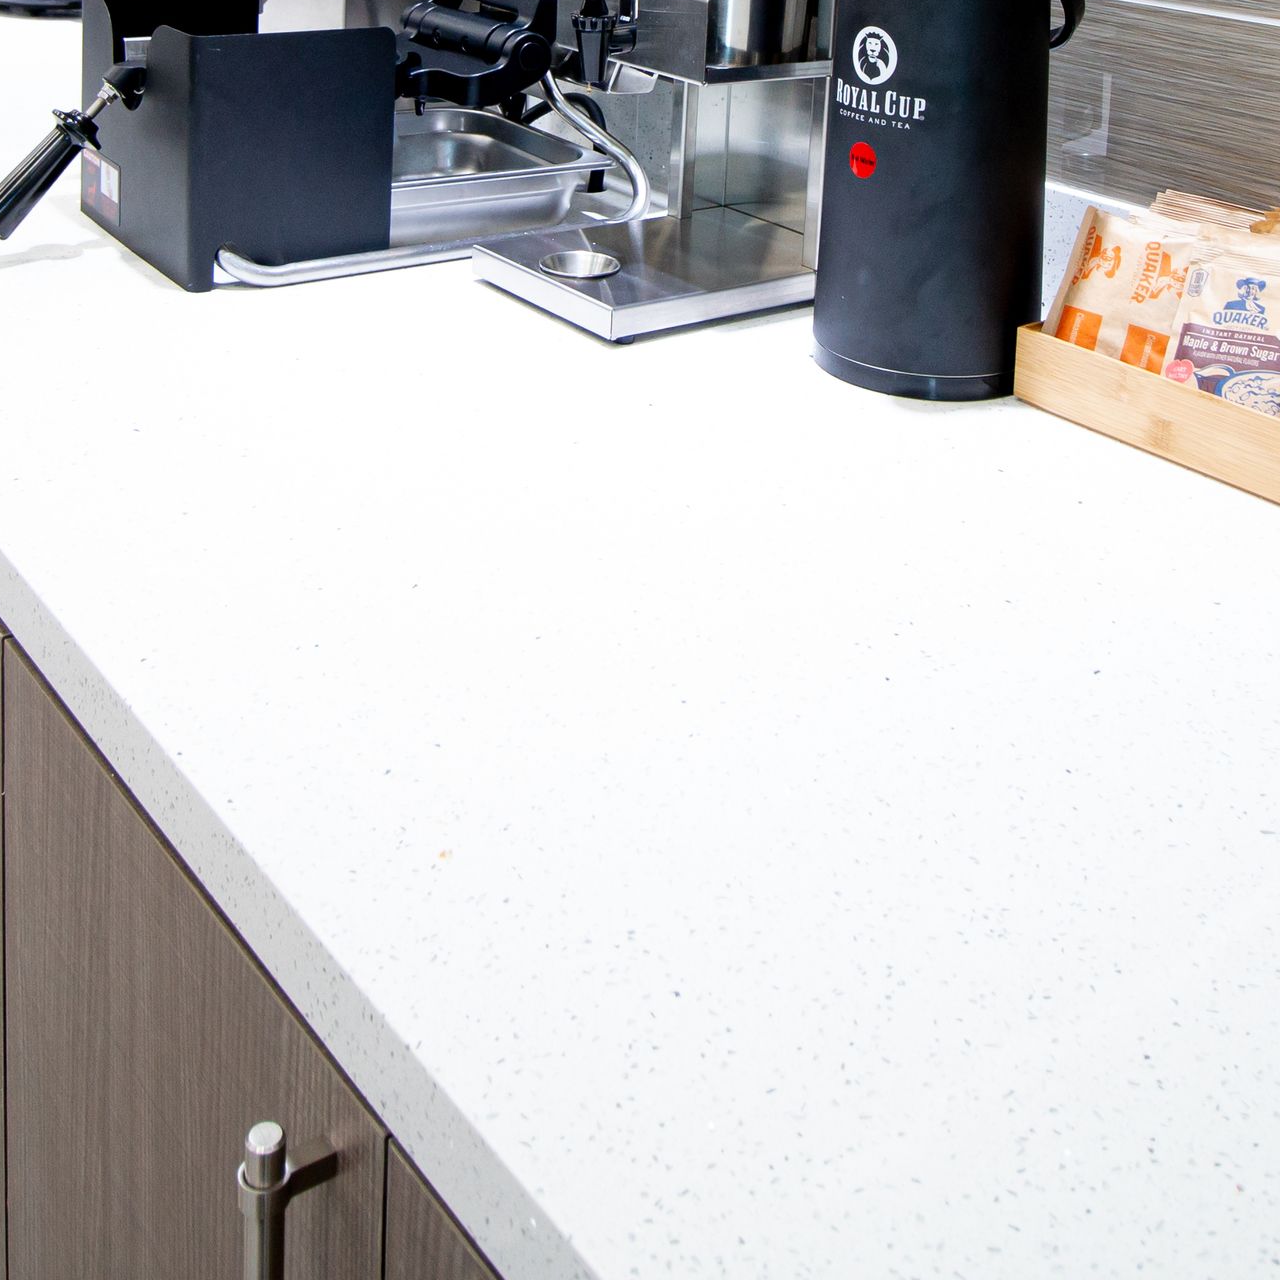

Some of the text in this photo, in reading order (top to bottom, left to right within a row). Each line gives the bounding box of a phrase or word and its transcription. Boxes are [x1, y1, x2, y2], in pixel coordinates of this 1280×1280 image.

[836, 78, 926, 120] ROYAL CUP
[839, 108, 910, 129] COFFEE AND TEA
[1131, 241, 1161, 304] QUAKER
[1213, 311, 1268, 330] QUAKER
[1201, 328, 1232, 338] INSTANT
[1234, 332, 1265, 342] OATMEAL
[1182, 335, 1280, 361] Maple & Brown Sugar
